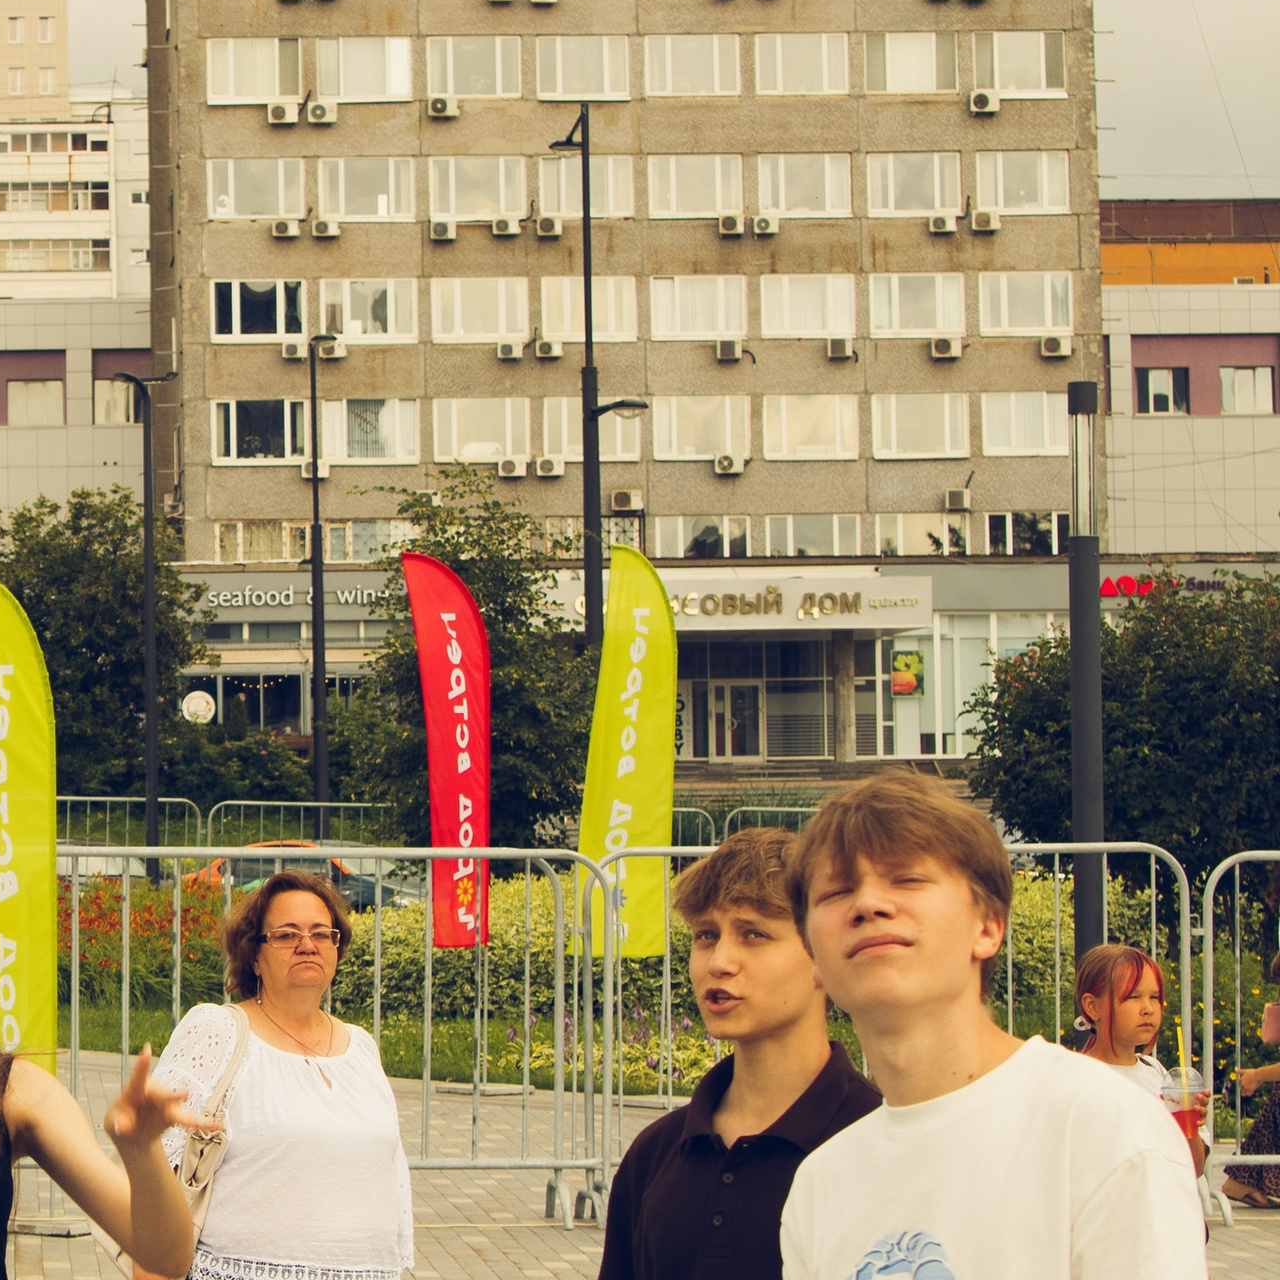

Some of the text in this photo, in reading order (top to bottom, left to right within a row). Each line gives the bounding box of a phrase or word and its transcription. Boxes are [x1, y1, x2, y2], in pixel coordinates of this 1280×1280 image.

[207, 584, 294, 607] seafood
[797, 592, 862, 620] ДОМ
[869, 596, 919, 609] ЦЕНТР
